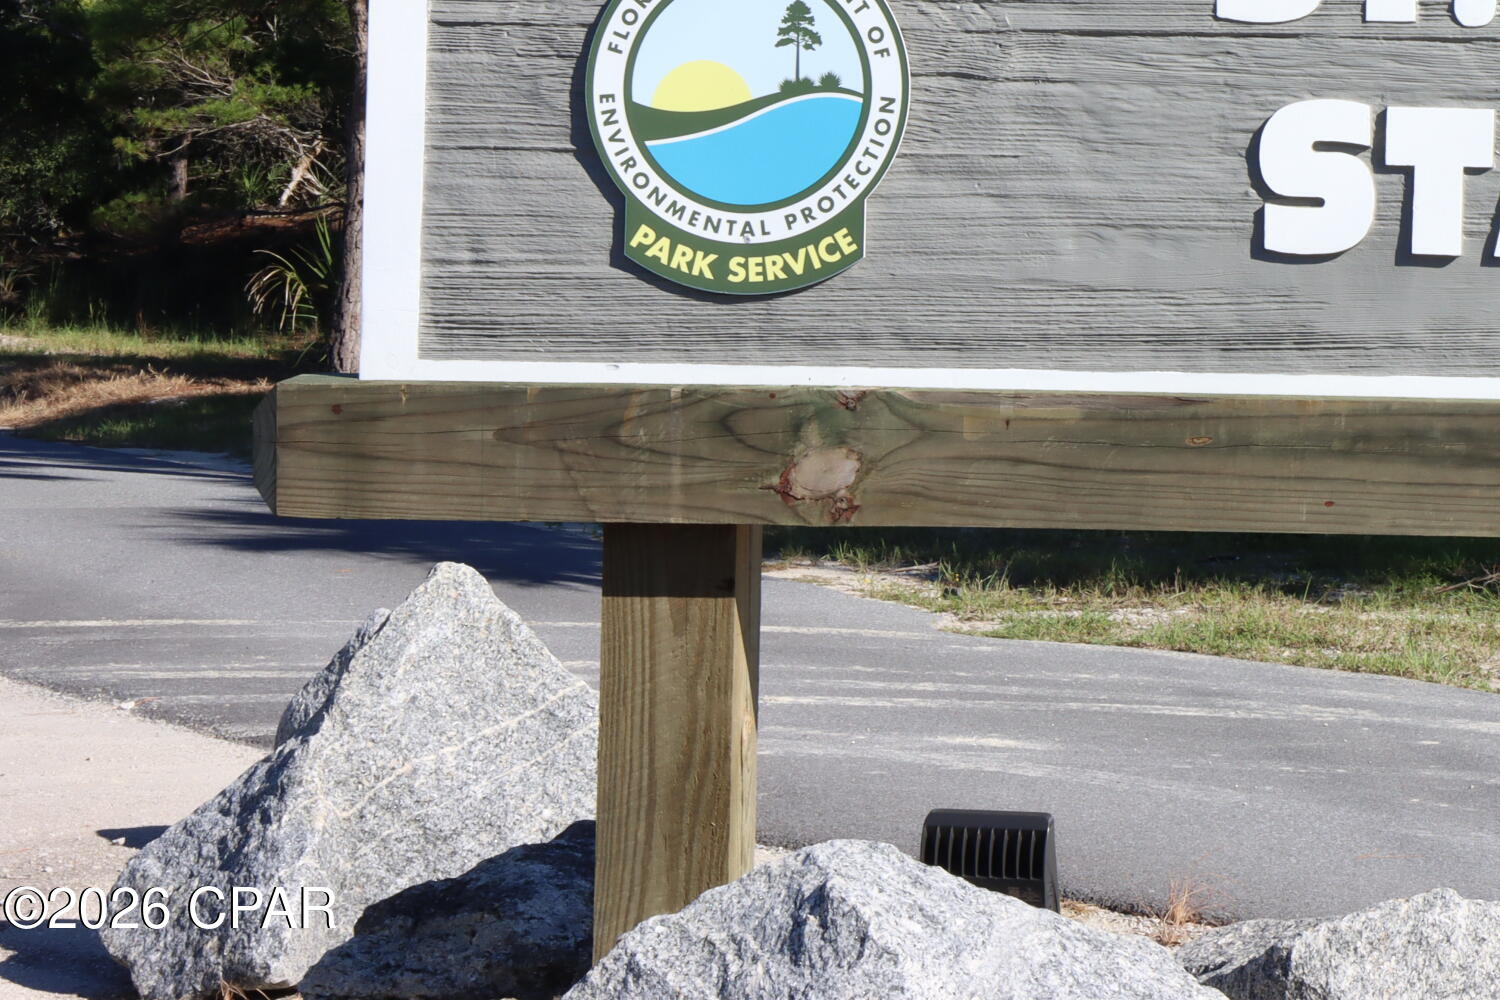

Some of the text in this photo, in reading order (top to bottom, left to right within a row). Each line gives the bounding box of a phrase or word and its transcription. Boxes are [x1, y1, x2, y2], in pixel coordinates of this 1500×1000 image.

[867, 26, 890, 59] OF
[599, 93, 896, 237] ENVIRONMENTAL PROTECTION
[630, 223, 859, 283] PARK SERVICE
